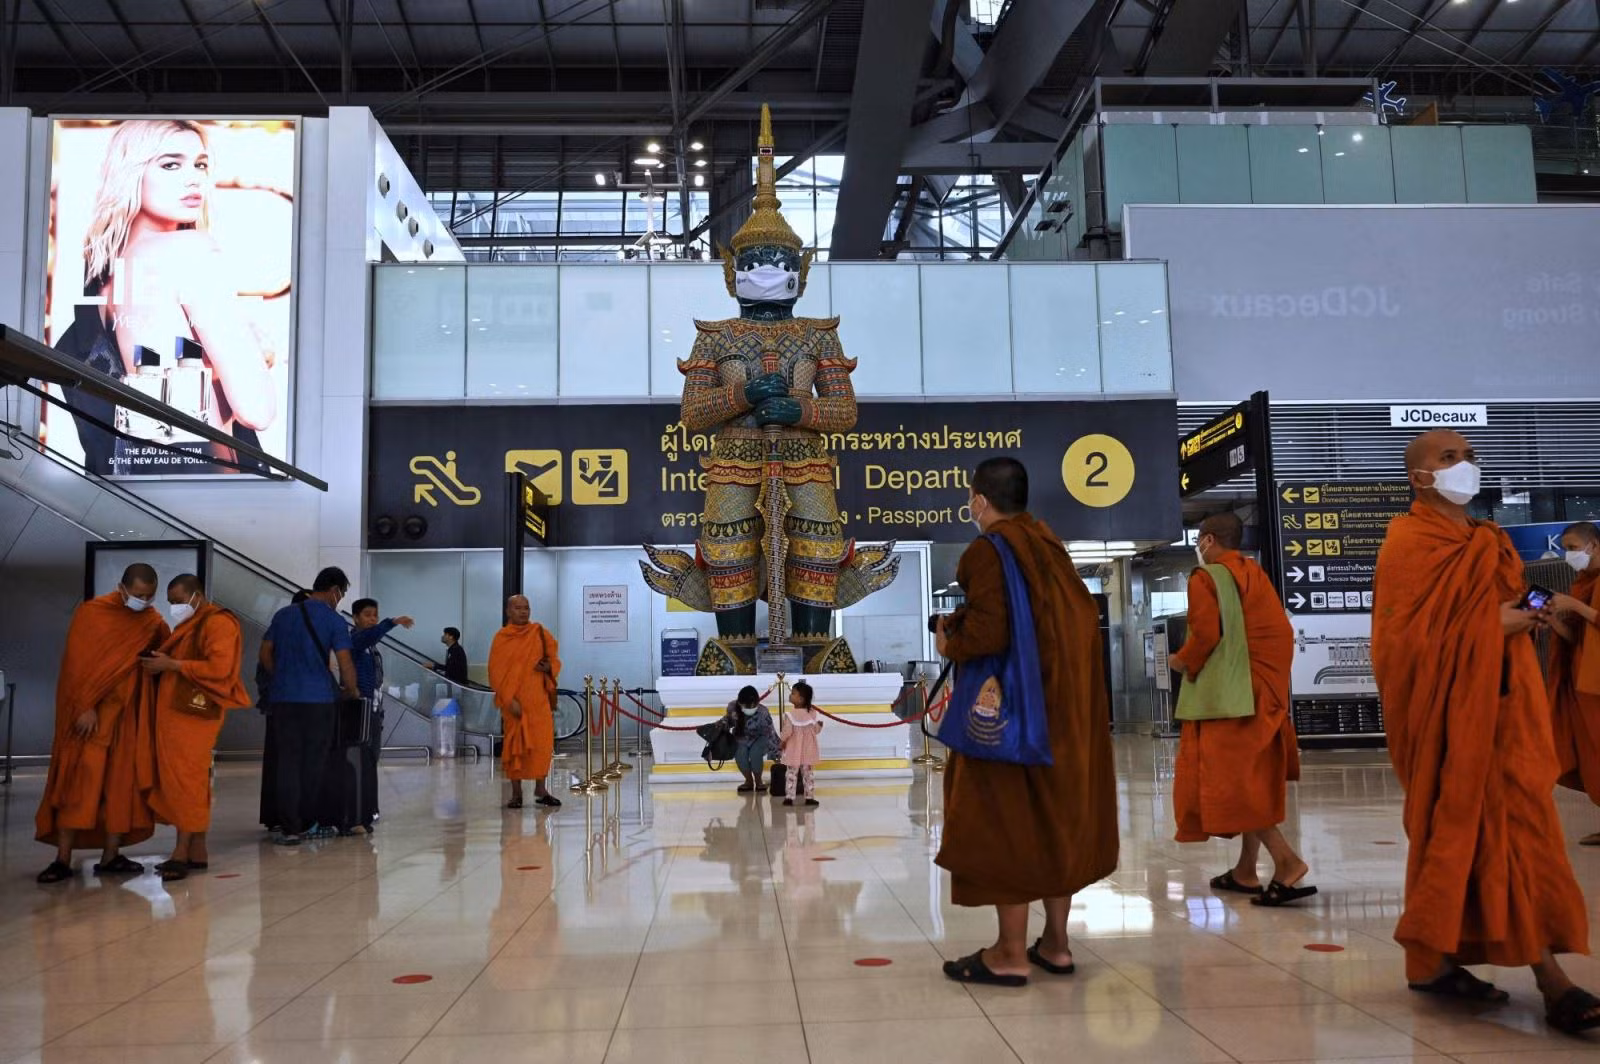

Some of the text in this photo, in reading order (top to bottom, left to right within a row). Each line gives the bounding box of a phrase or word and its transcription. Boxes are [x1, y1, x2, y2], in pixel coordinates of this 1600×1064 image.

[1400, 409, 1478, 423] JCDecaux
[125, 447, 140, 455] THE
[142, 447, 157, 455] EAU
[108, 457, 115, 465] &
[117, 457, 132, 465] THE
[133, 457, 152, 465] NEW
[154, 457, 169, 465] EAU
[171, 457, 182, 465] DE
[1085, 451, 1109, 486] 2
[865, 465, 974, 495] Departu
[868, 507, 952, 527] Passport
